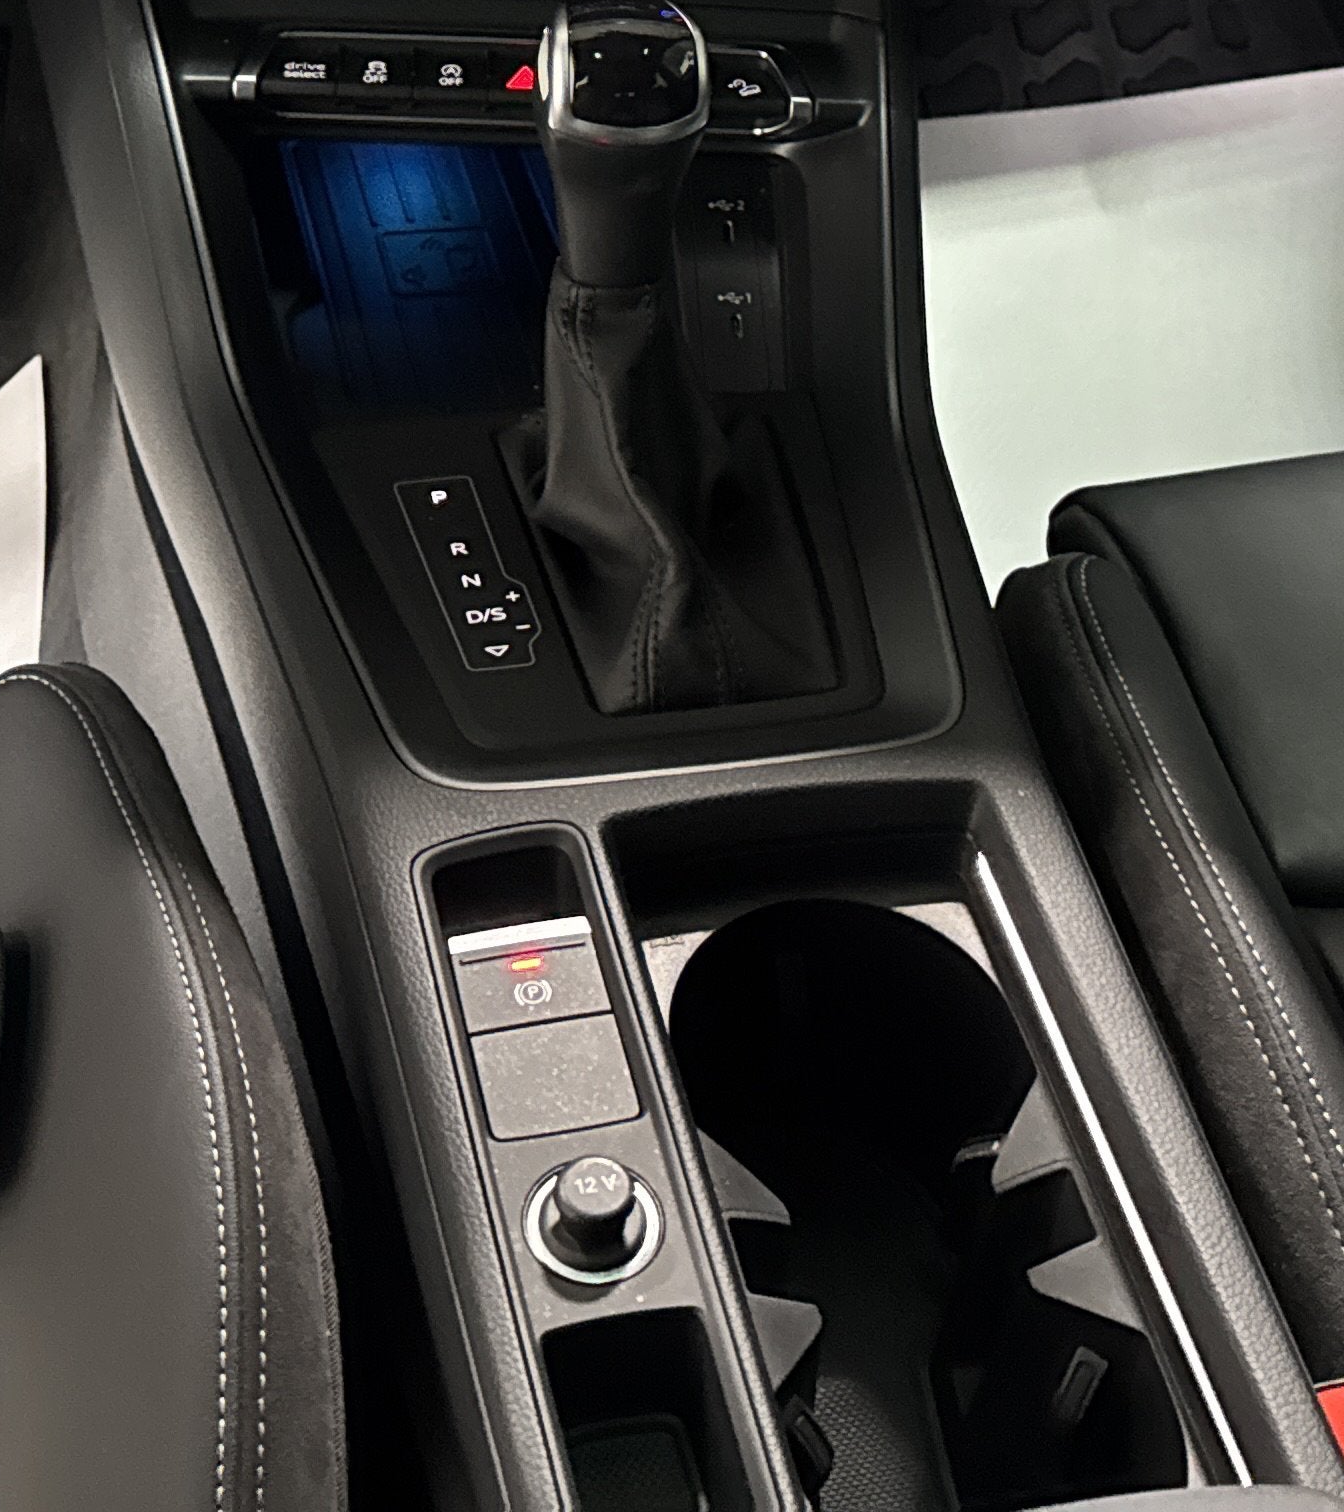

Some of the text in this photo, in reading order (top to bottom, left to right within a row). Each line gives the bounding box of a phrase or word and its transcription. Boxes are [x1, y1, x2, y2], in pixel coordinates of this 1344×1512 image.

[284, 61, 326, 71] drive
[283, 70, 326, 80] select
[363, 72, 388, 84] OFF
[438, 76, 464, 87] OFF
[430, 490, 448, 505] P
[449, 541, 469, 557] R
[460, 573, 482, 589] N
[464, 606, 507, 625] D/S
[574, 1176, 599, 1195] 12
